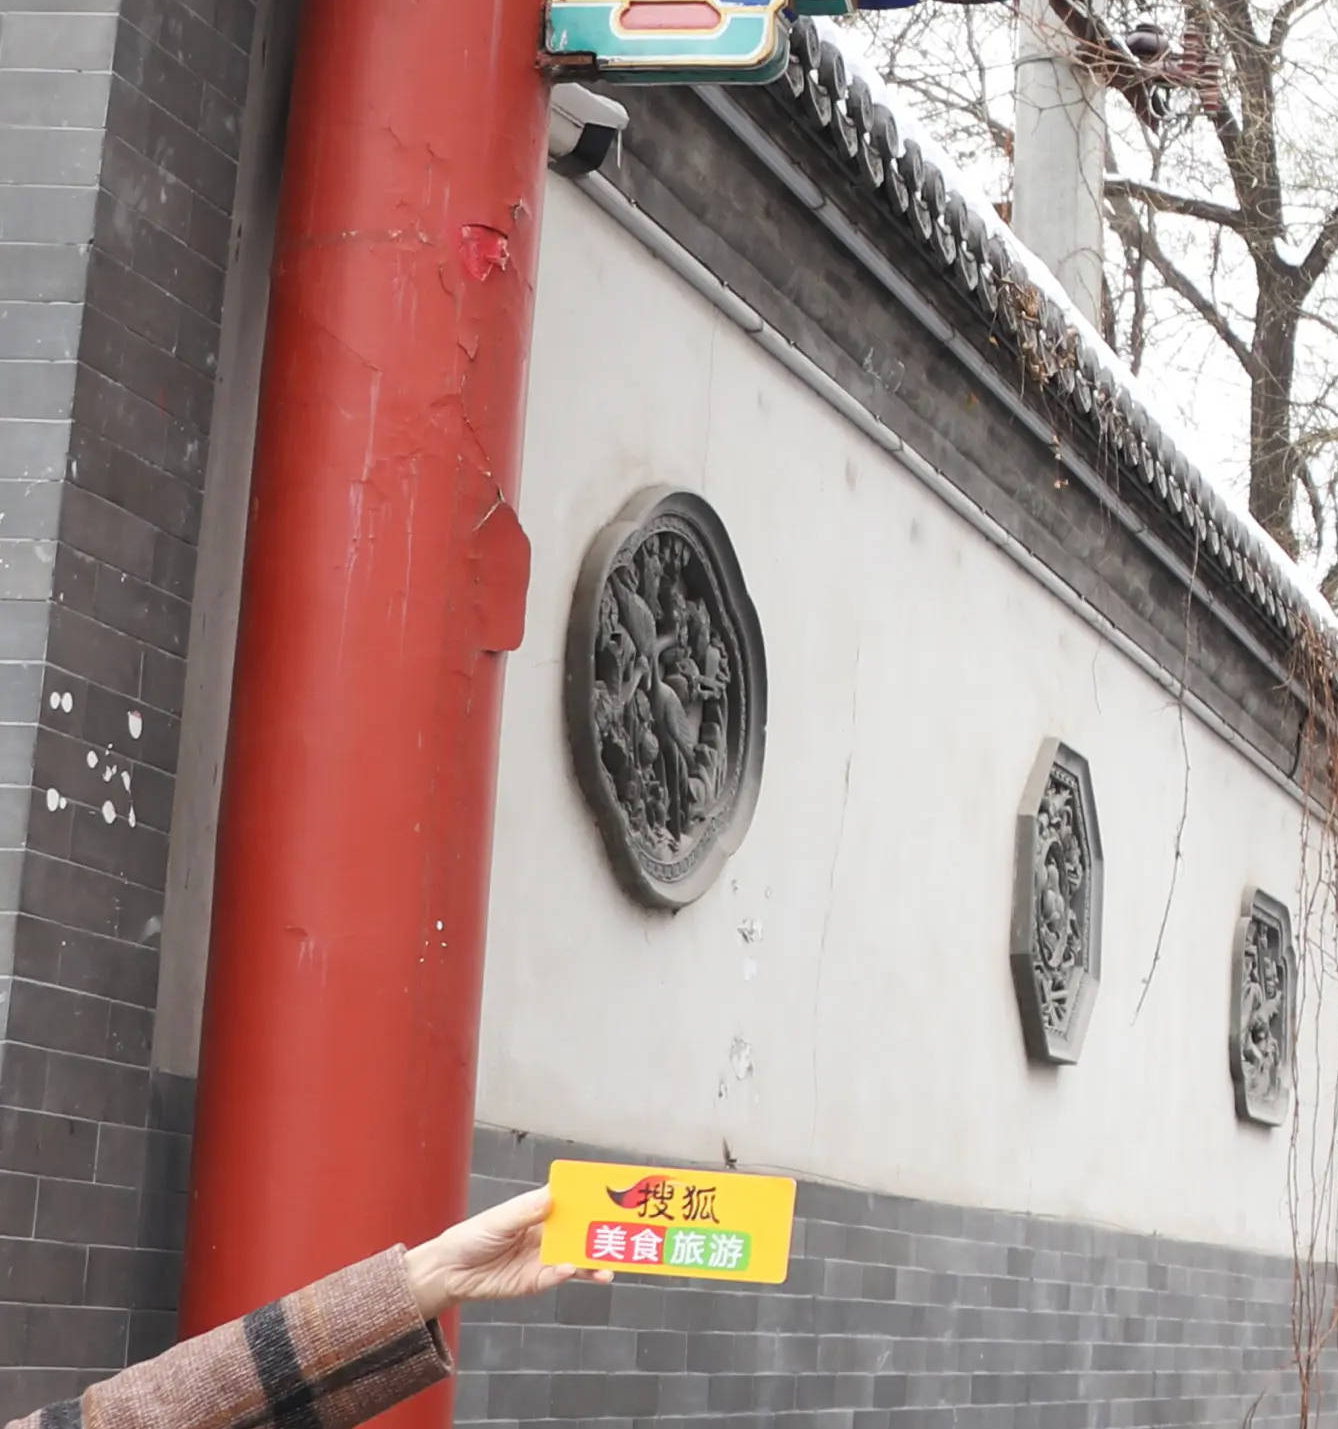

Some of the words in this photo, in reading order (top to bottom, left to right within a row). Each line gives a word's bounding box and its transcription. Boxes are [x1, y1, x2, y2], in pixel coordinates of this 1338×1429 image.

[636, 1180, 720, 1224] 搜狐
[592, 1225, 744, 1269] 美食旅游
